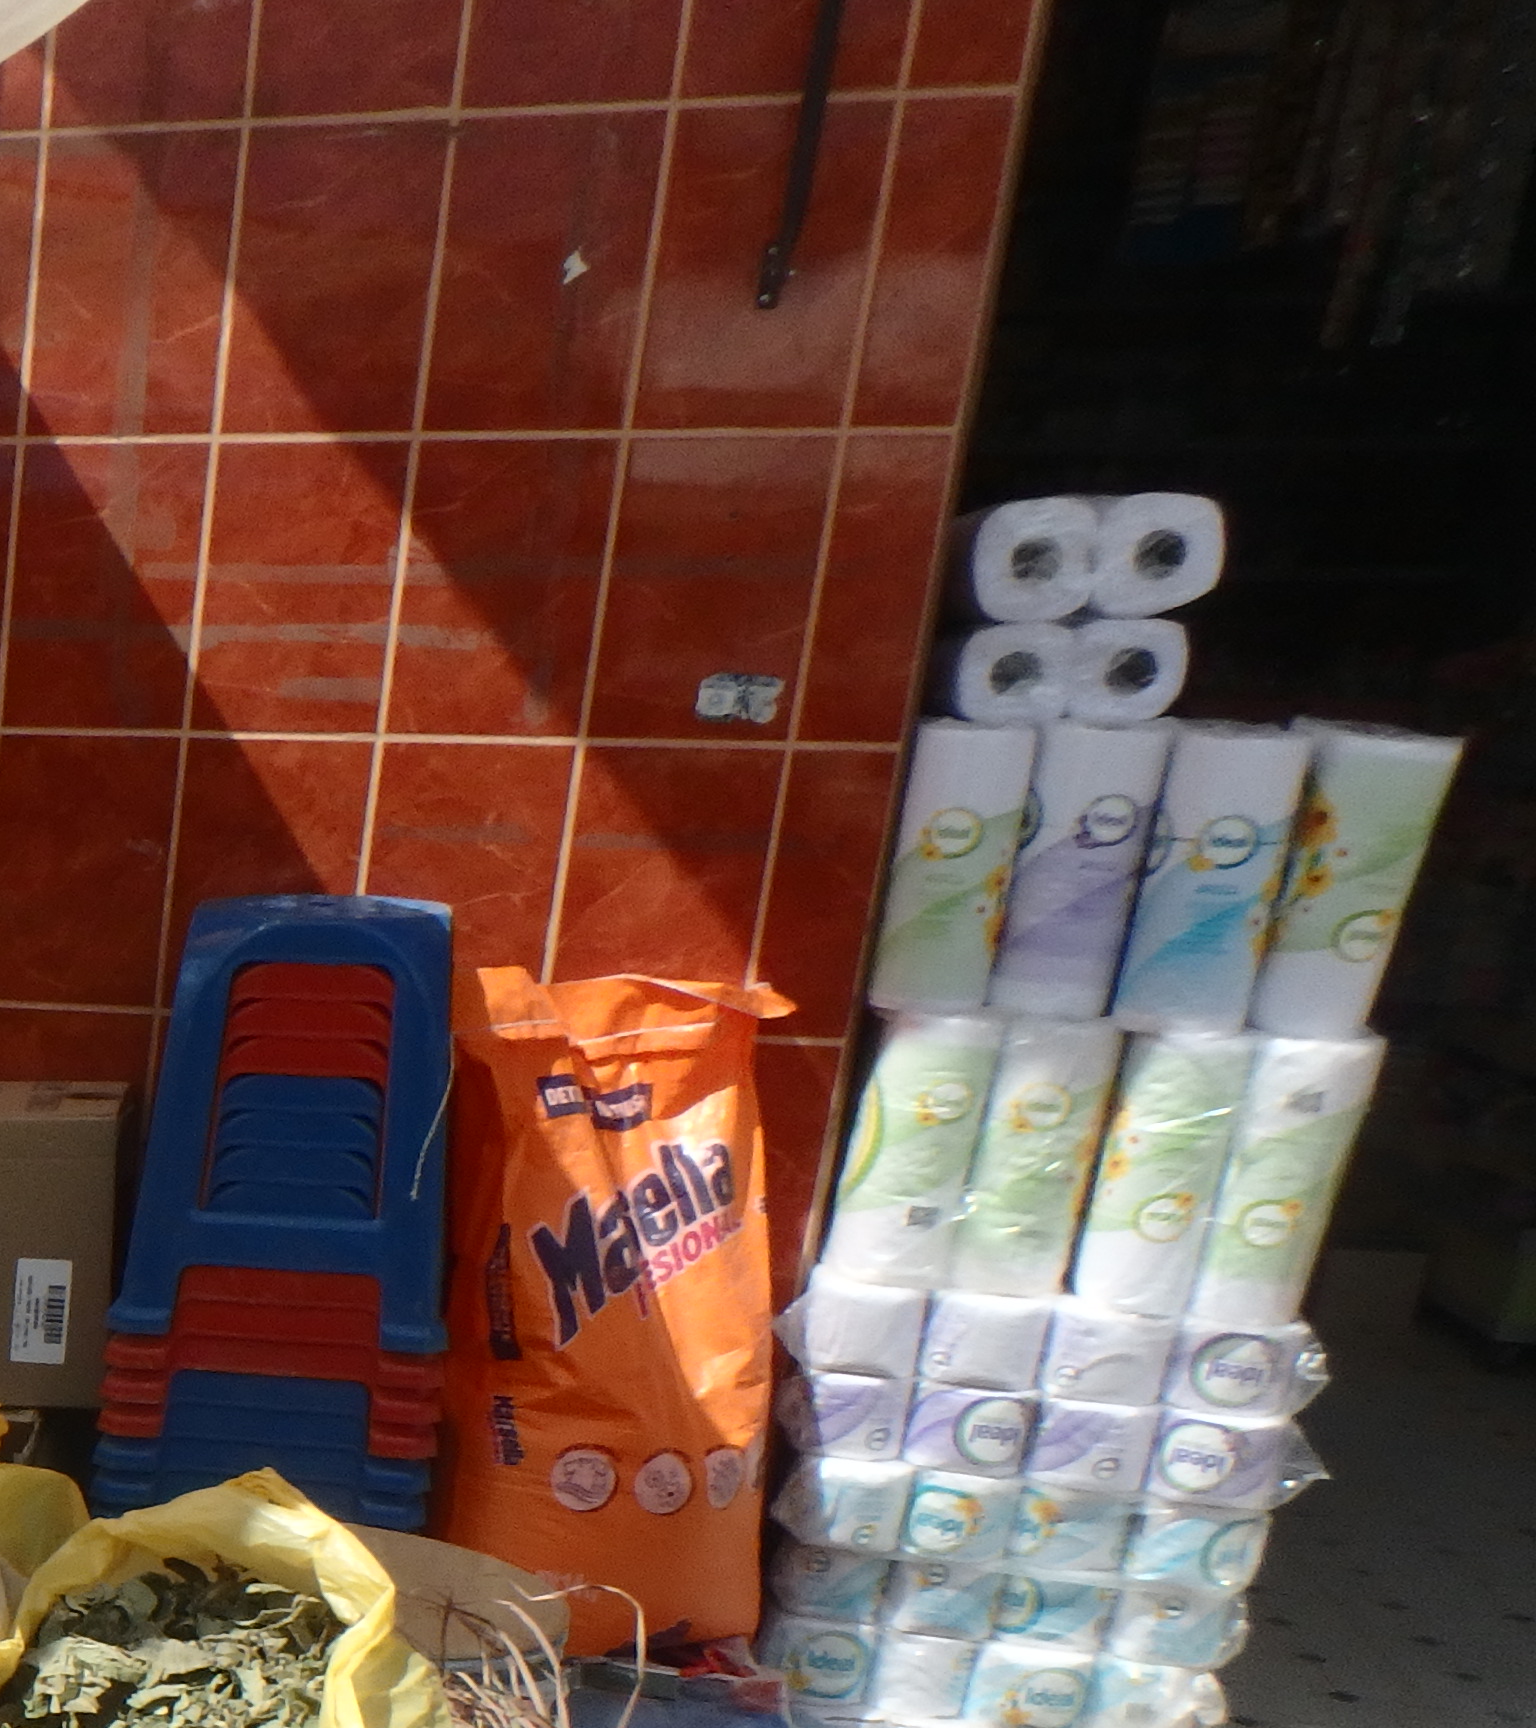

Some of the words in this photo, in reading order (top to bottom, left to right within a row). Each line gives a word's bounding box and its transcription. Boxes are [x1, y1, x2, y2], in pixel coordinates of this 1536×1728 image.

[1205, 1358, 1266, 1385] Ideal
[970, 1422, 1020, 1446] Ideal
[1169, 1446, 1226, 1474] Ideal
[806, 1648, 857, 1673] Ideal
[1025, 1687, 1075, 1709] Ideal
